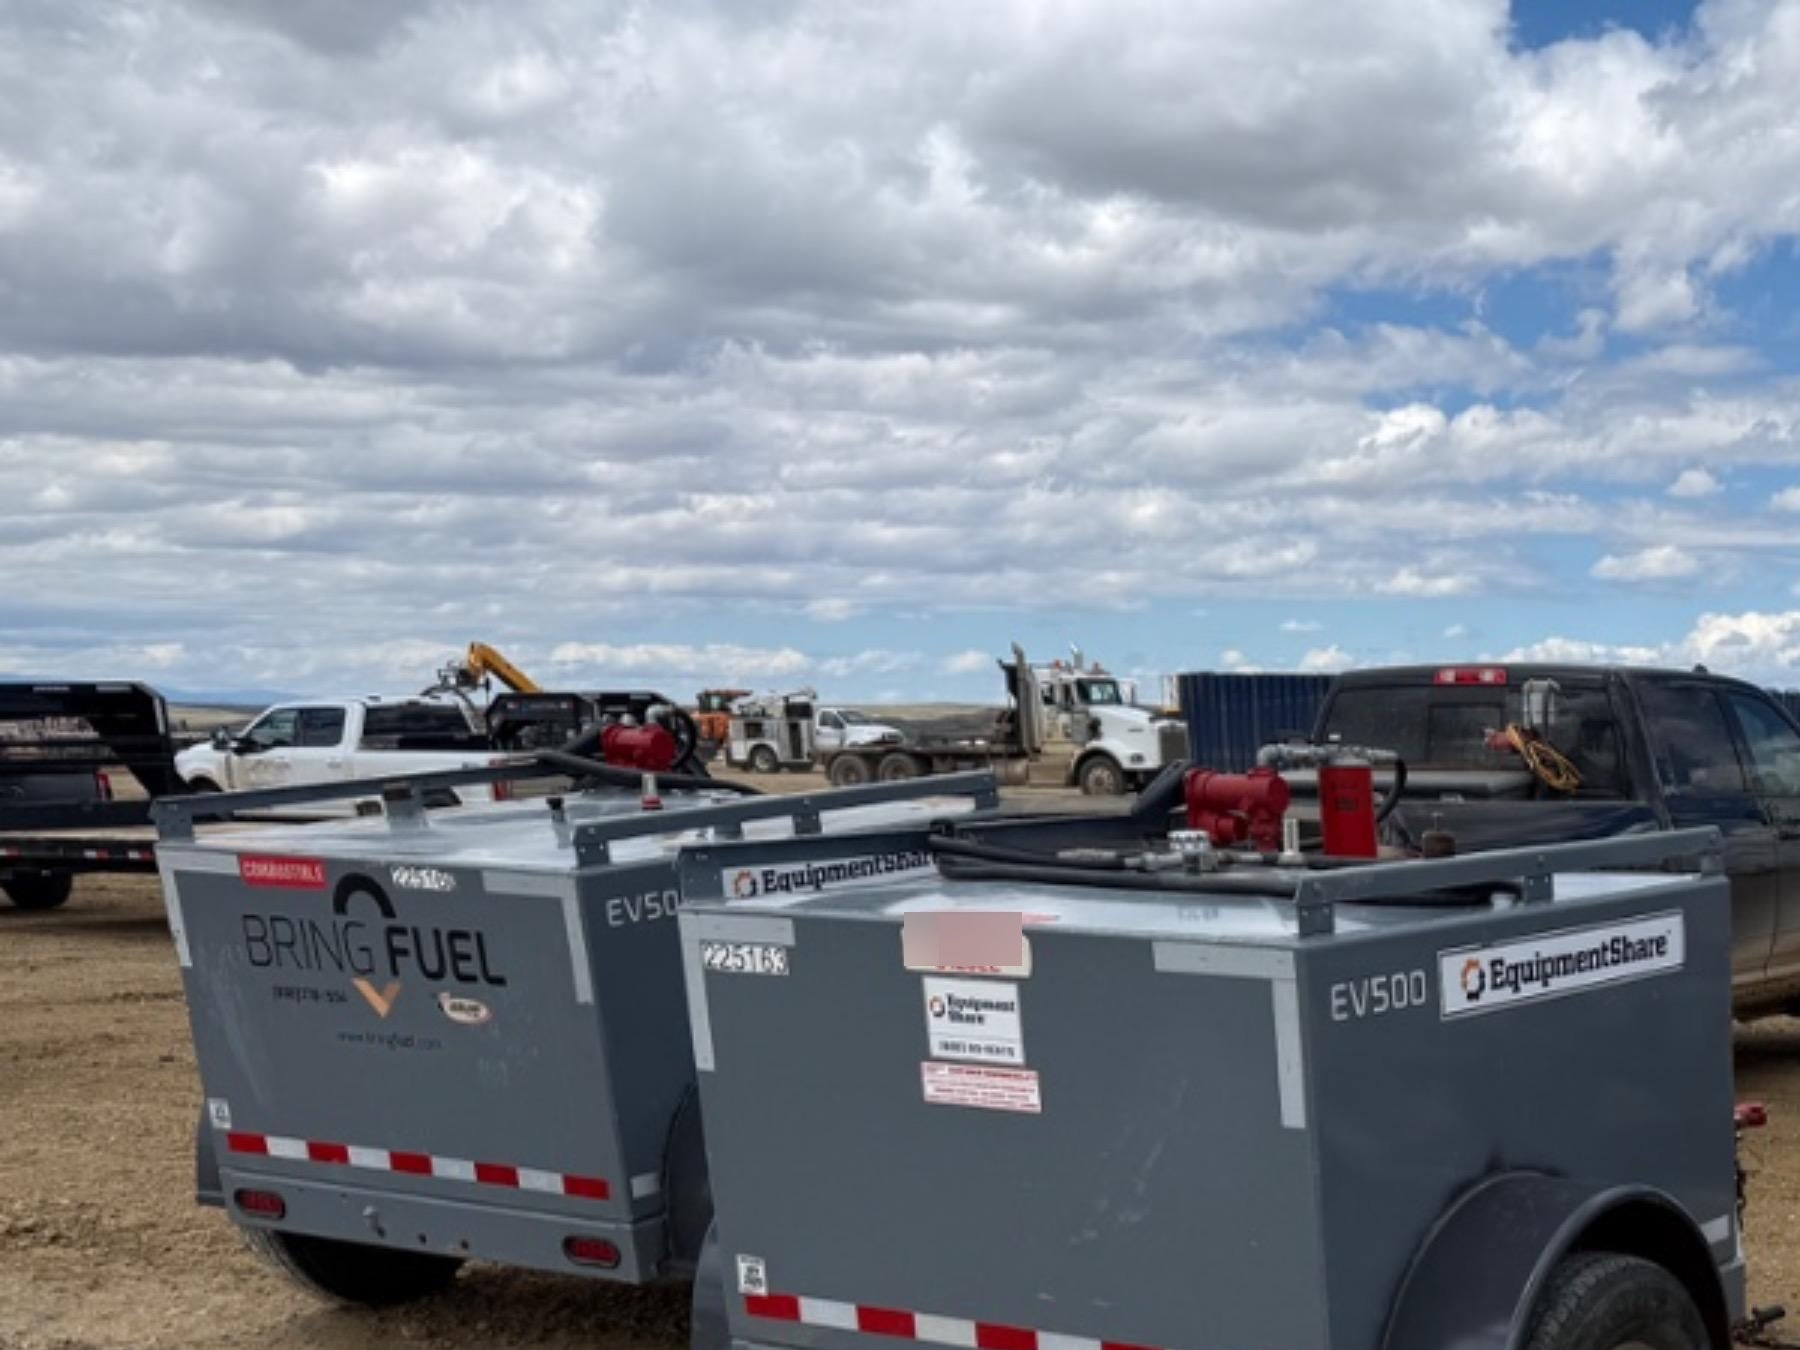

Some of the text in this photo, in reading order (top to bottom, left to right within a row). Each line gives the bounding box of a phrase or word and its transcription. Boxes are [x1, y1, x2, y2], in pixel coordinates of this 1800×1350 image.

[761, 852, 937, 892] EquipmentShar
[605, 889, 679, 928] EV50
[242, 914, 507, 986] BRING FUEL
[1489, 933, 1668, 993] EquipmentShare
[1331, 970, 1426, 1021] EV500
